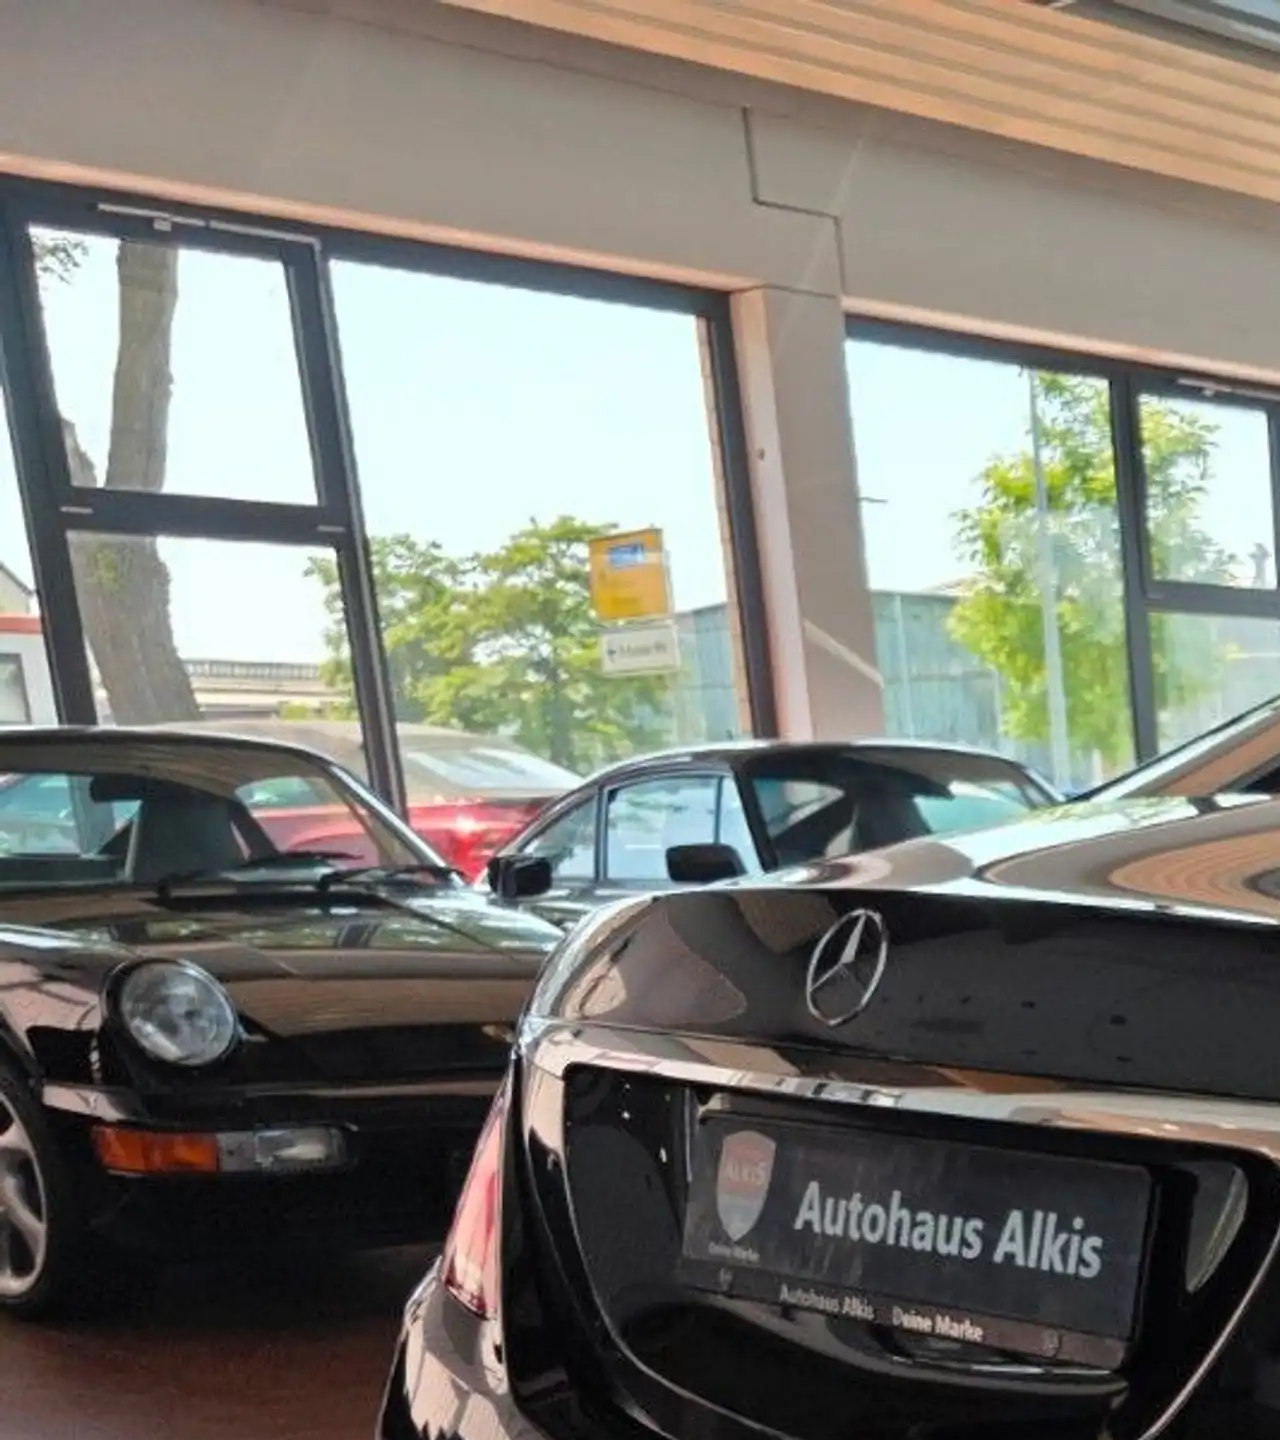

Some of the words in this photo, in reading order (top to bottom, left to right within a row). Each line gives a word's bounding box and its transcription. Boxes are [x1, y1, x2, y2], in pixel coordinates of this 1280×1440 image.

[793, 1180, 985, 1260] Autohaus
[993, 1209, 1104, 1278] Alkis
[841, 1295, 875, 1321] Alkis
[891, 1305, 933, 1332] Deine
[934, 1312, 984, 1343] Marke
